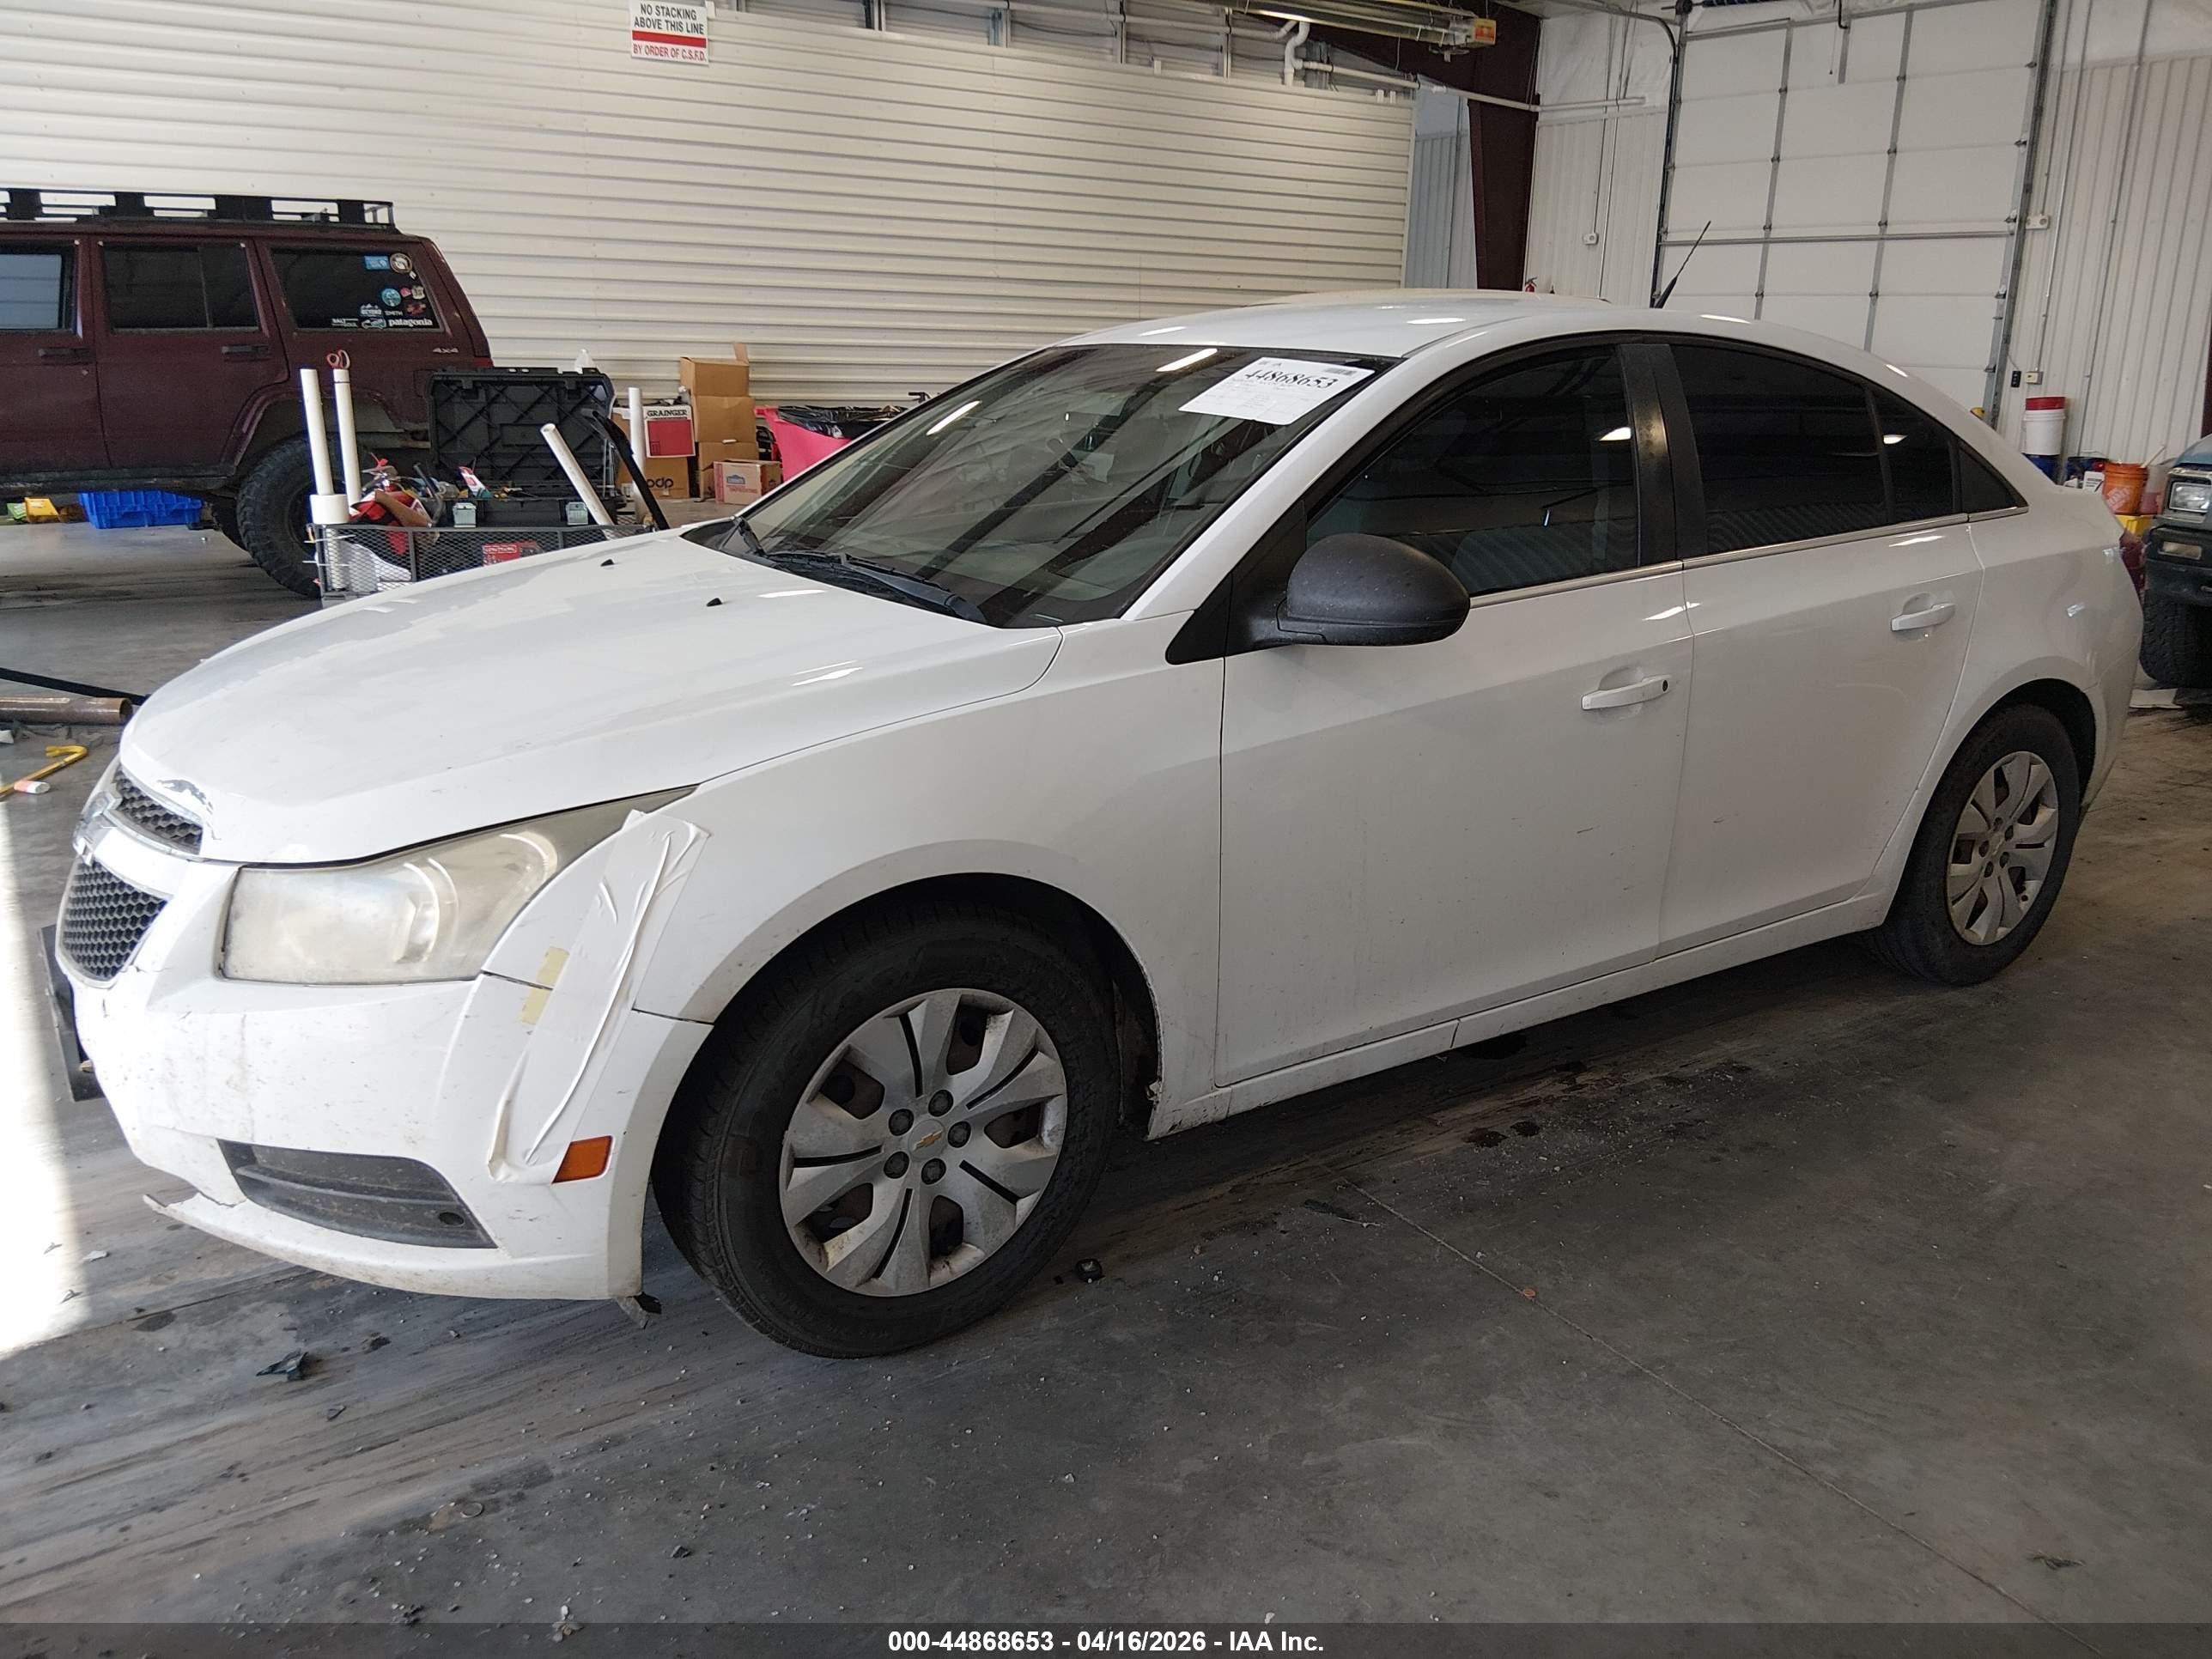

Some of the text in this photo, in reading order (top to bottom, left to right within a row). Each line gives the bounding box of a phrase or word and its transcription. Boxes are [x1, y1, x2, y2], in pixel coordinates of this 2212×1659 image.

[641, 3, 697, 21] NO STACKING
[634, 16, 704, 34] ABOVE THIS LINE
[633, 44, 642, 54] BY
[645, 46, 670, 58] ORDER
[671, 48, 679, 58] OF
[388, 318, 433, 327] patagonia
[1245, 370, 1339, 388] 44868653
